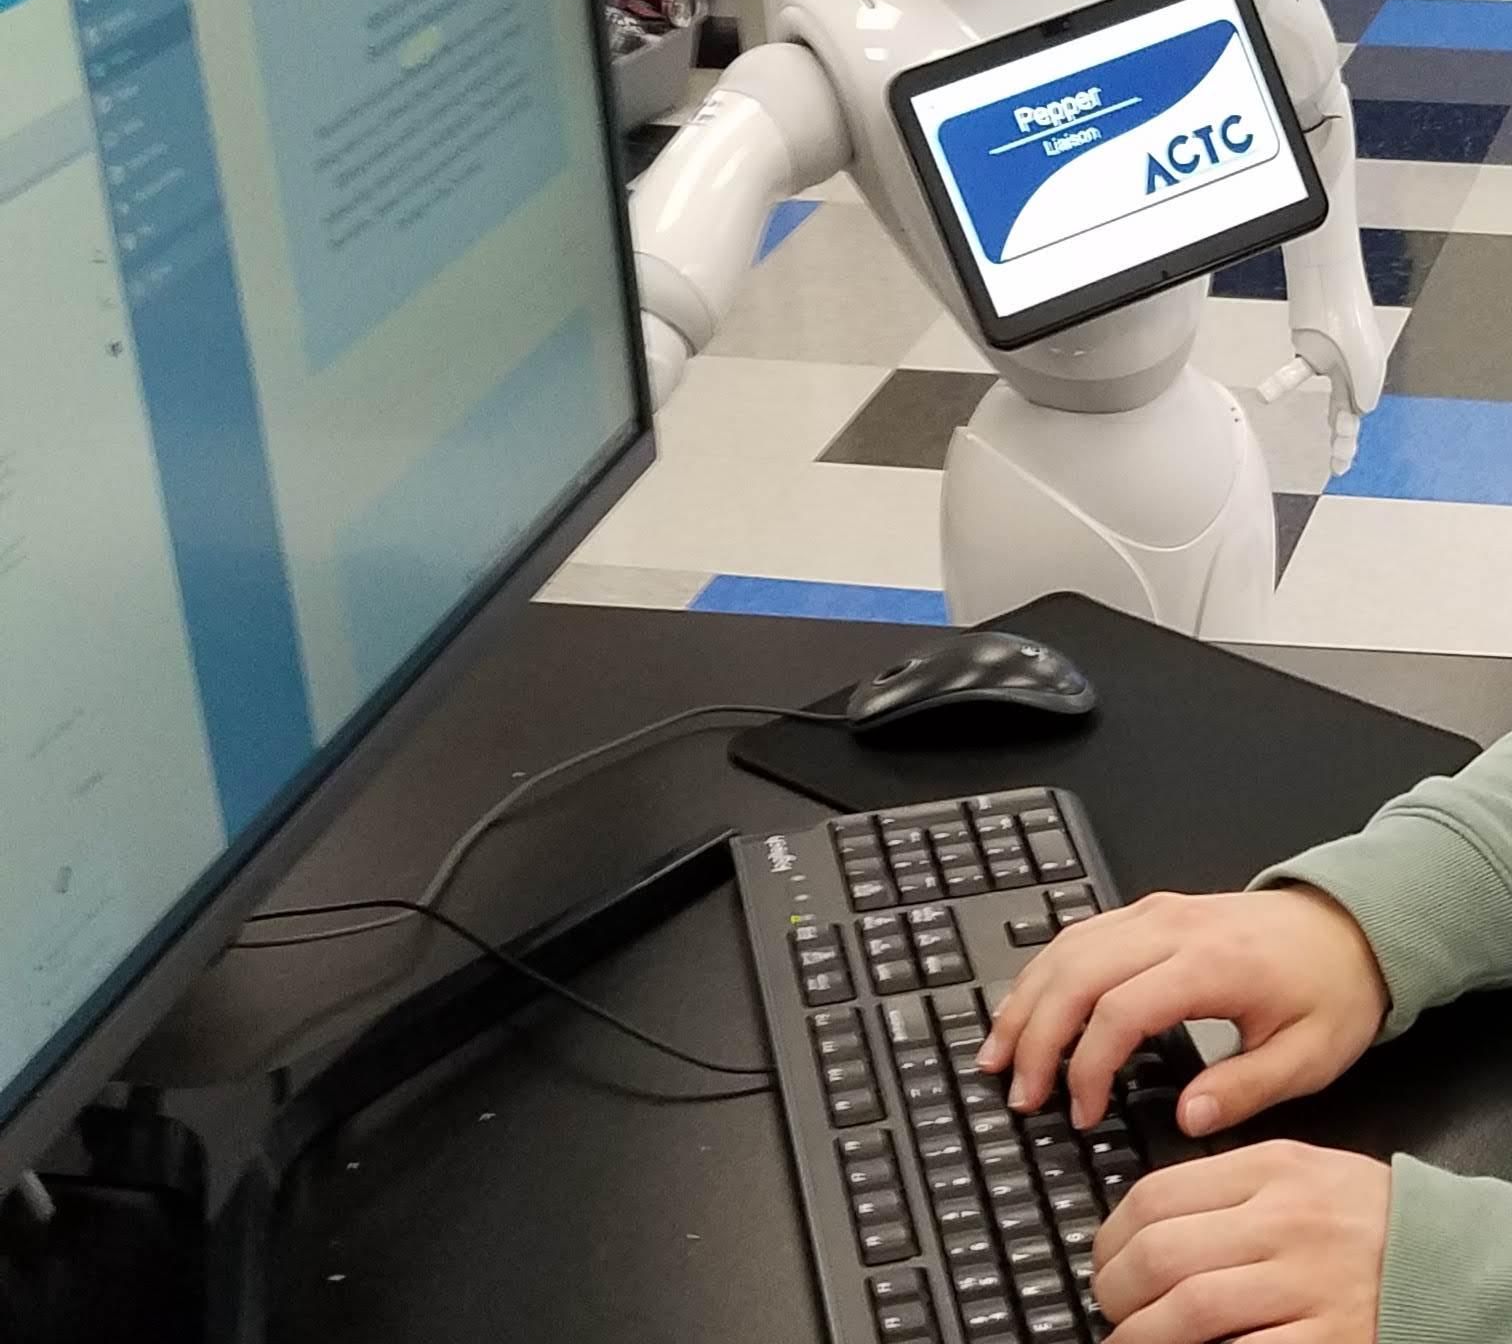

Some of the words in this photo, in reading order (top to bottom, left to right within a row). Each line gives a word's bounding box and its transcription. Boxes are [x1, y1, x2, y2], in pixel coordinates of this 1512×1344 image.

[1013, 87, 1102, 133] Pepper
[1042, 127, 1103, 156] Liaison
[1145, 115, 1254, 195] ACTC
